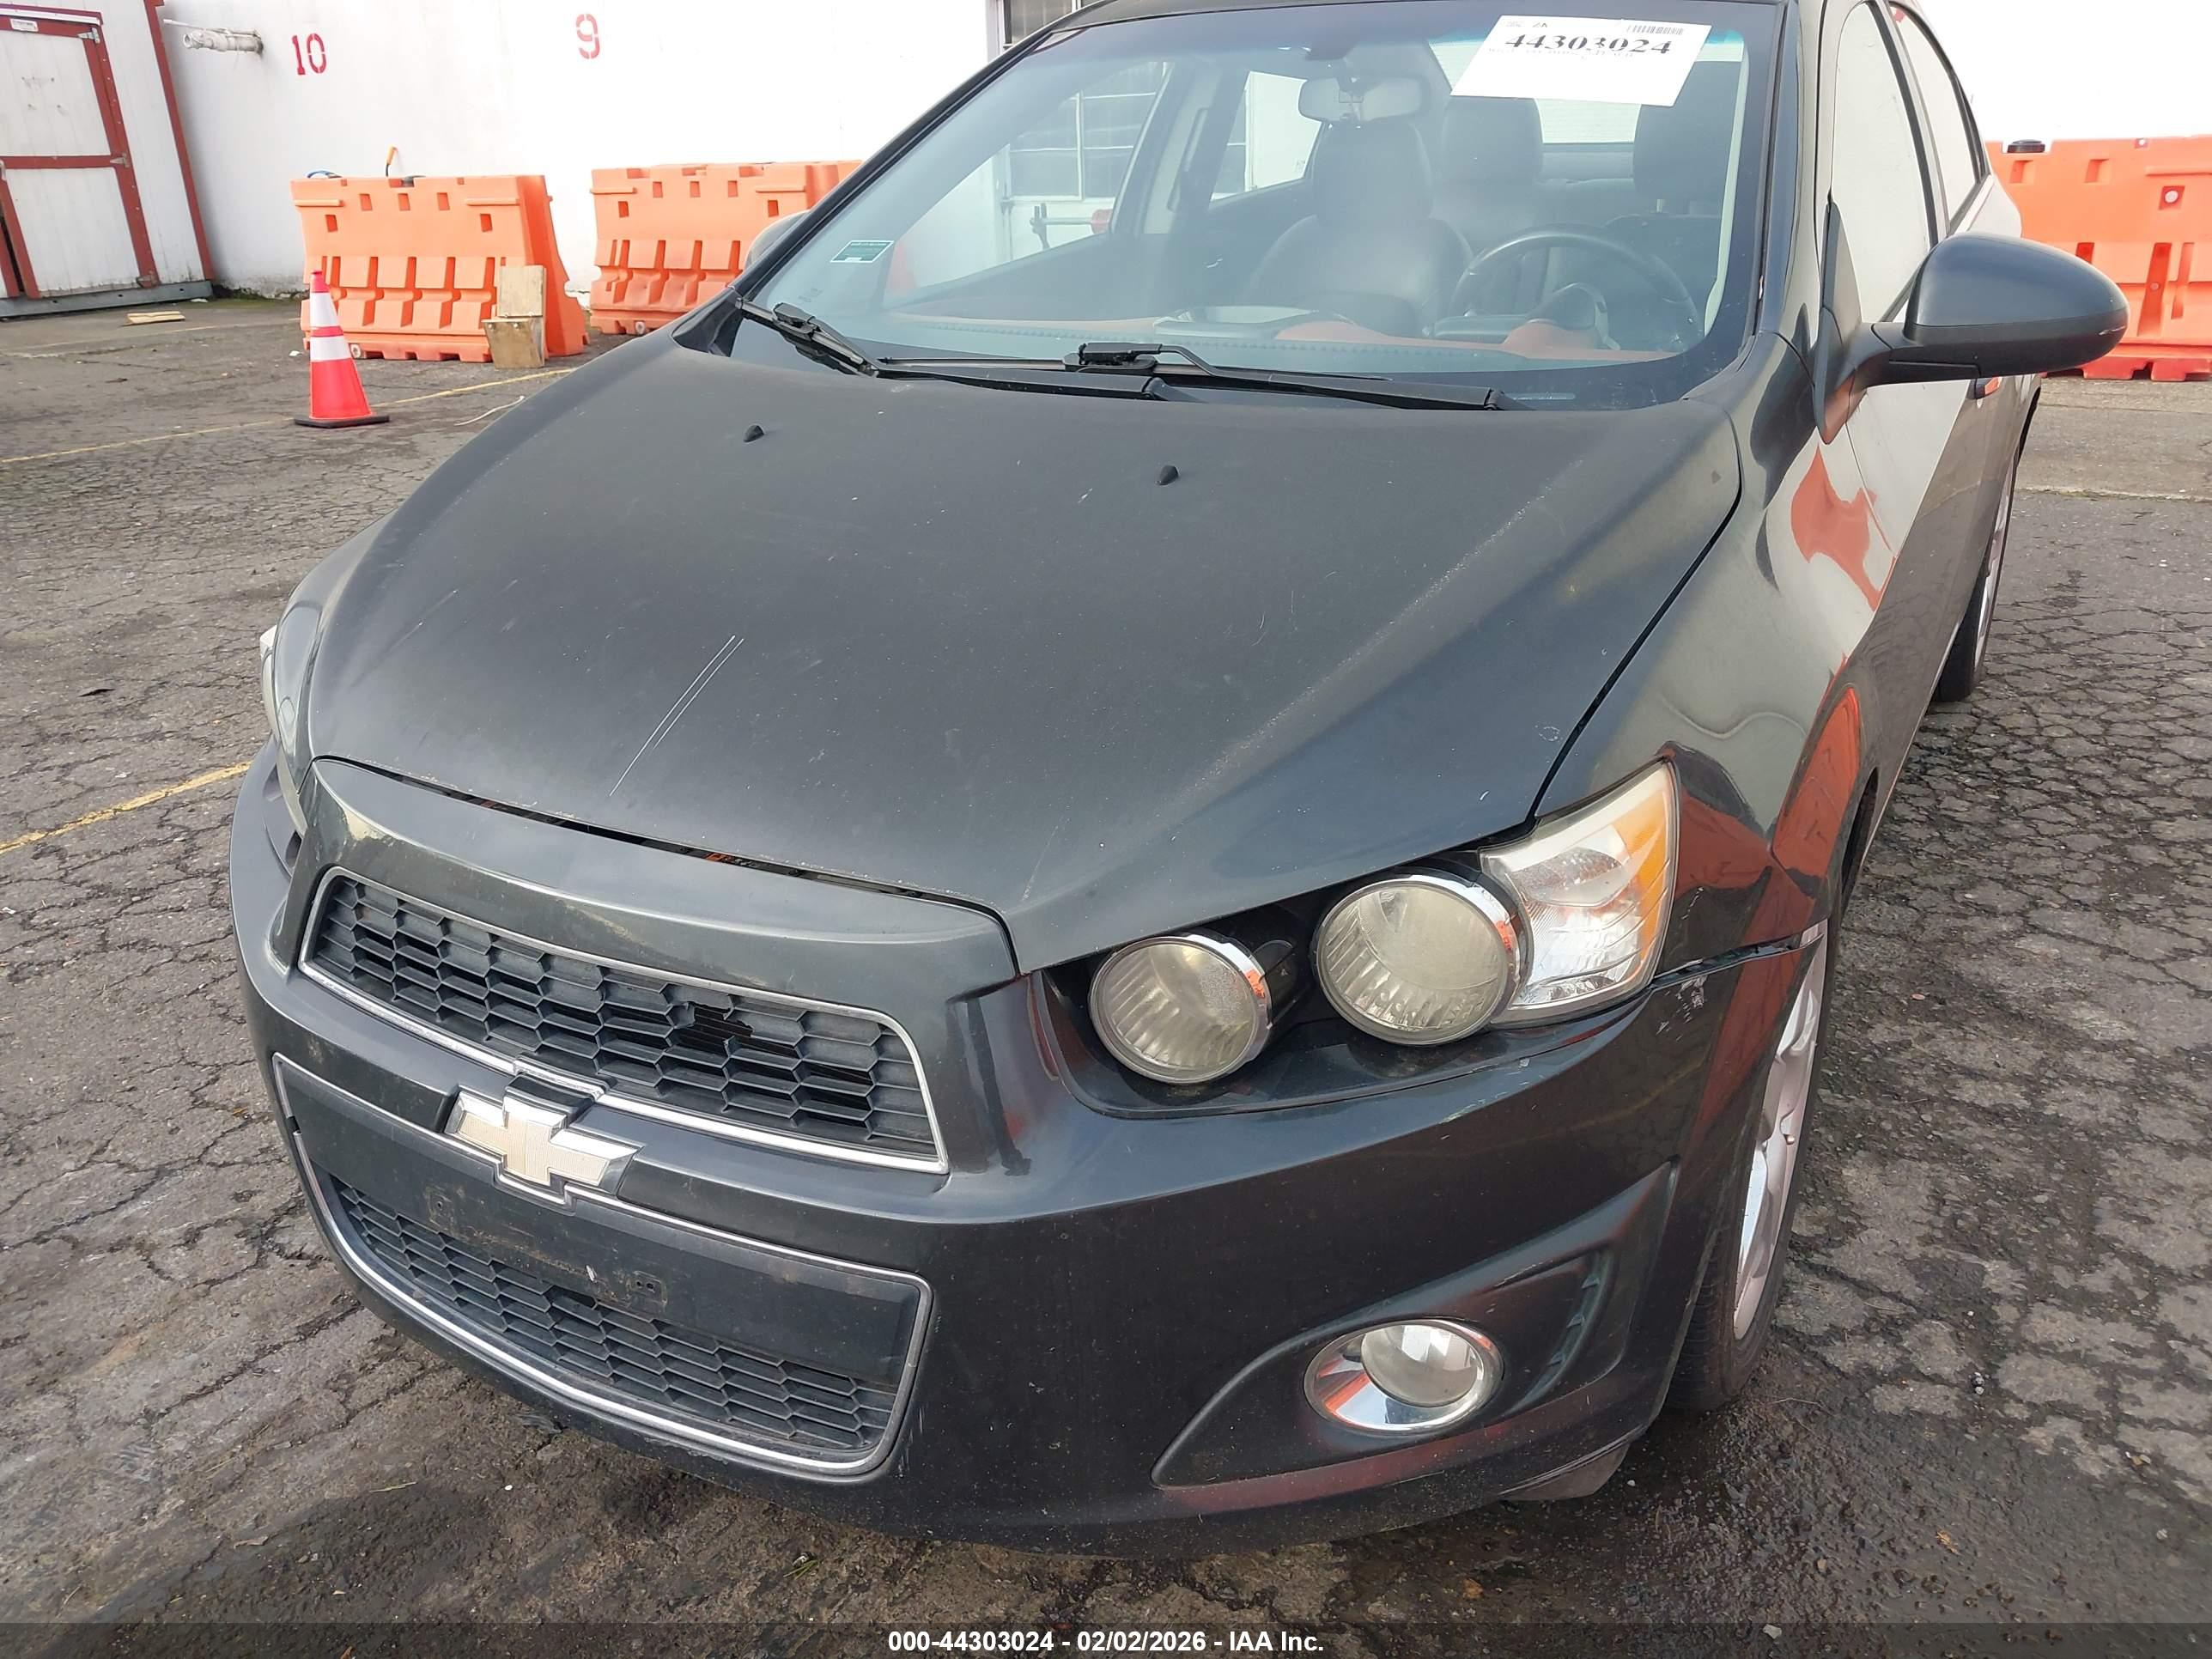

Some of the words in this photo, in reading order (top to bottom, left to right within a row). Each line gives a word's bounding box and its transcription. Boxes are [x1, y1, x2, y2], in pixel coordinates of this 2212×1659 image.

[292, 33, 327, 76] 10
[576, 15, 600, 59] 9
[1505, 34, 1672, 54] 44303024
